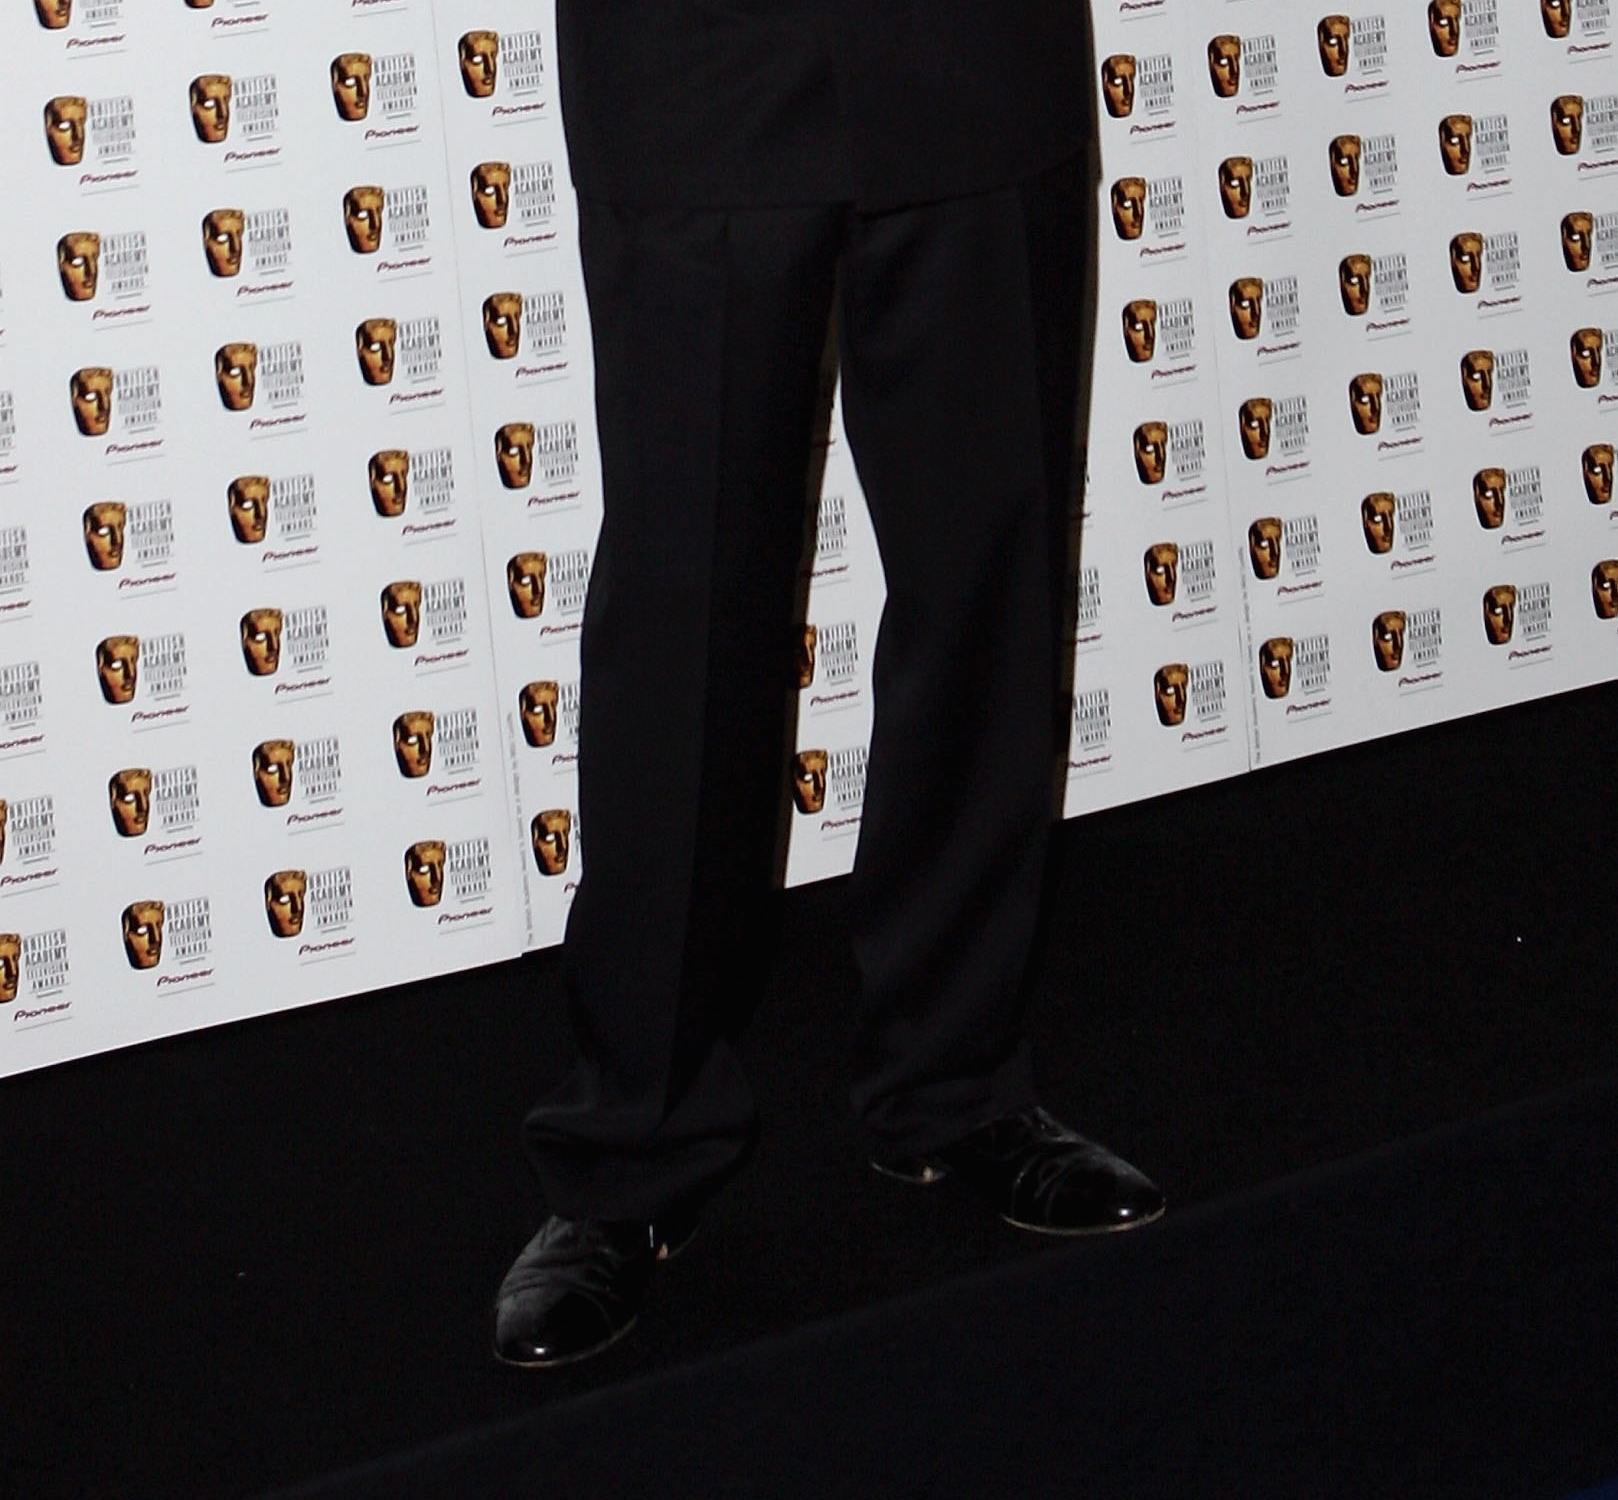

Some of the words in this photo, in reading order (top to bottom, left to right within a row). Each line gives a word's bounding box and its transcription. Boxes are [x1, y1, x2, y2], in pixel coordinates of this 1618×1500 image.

[373, 54, 415, 73] BRITISH
[375, 69, 415, 87] ACADEMY
[246, 209, 289, 229] BRITISH
[248, 225, 289, 243] ACADEMY
[398, 318, 439, 338] BRITISH
[400, 333, 440, 351] ACADEMY
[272, 475, 314, 496] BRITISH
[274, 490, 314, 509] ACADEMY
[141, 634, 185, 655] BRITISH
[143, 649, 185, 669] ACADEMY
[308, 868, 351, 889] BRITISH
[310, 882, 351, 902] ACADEMY
